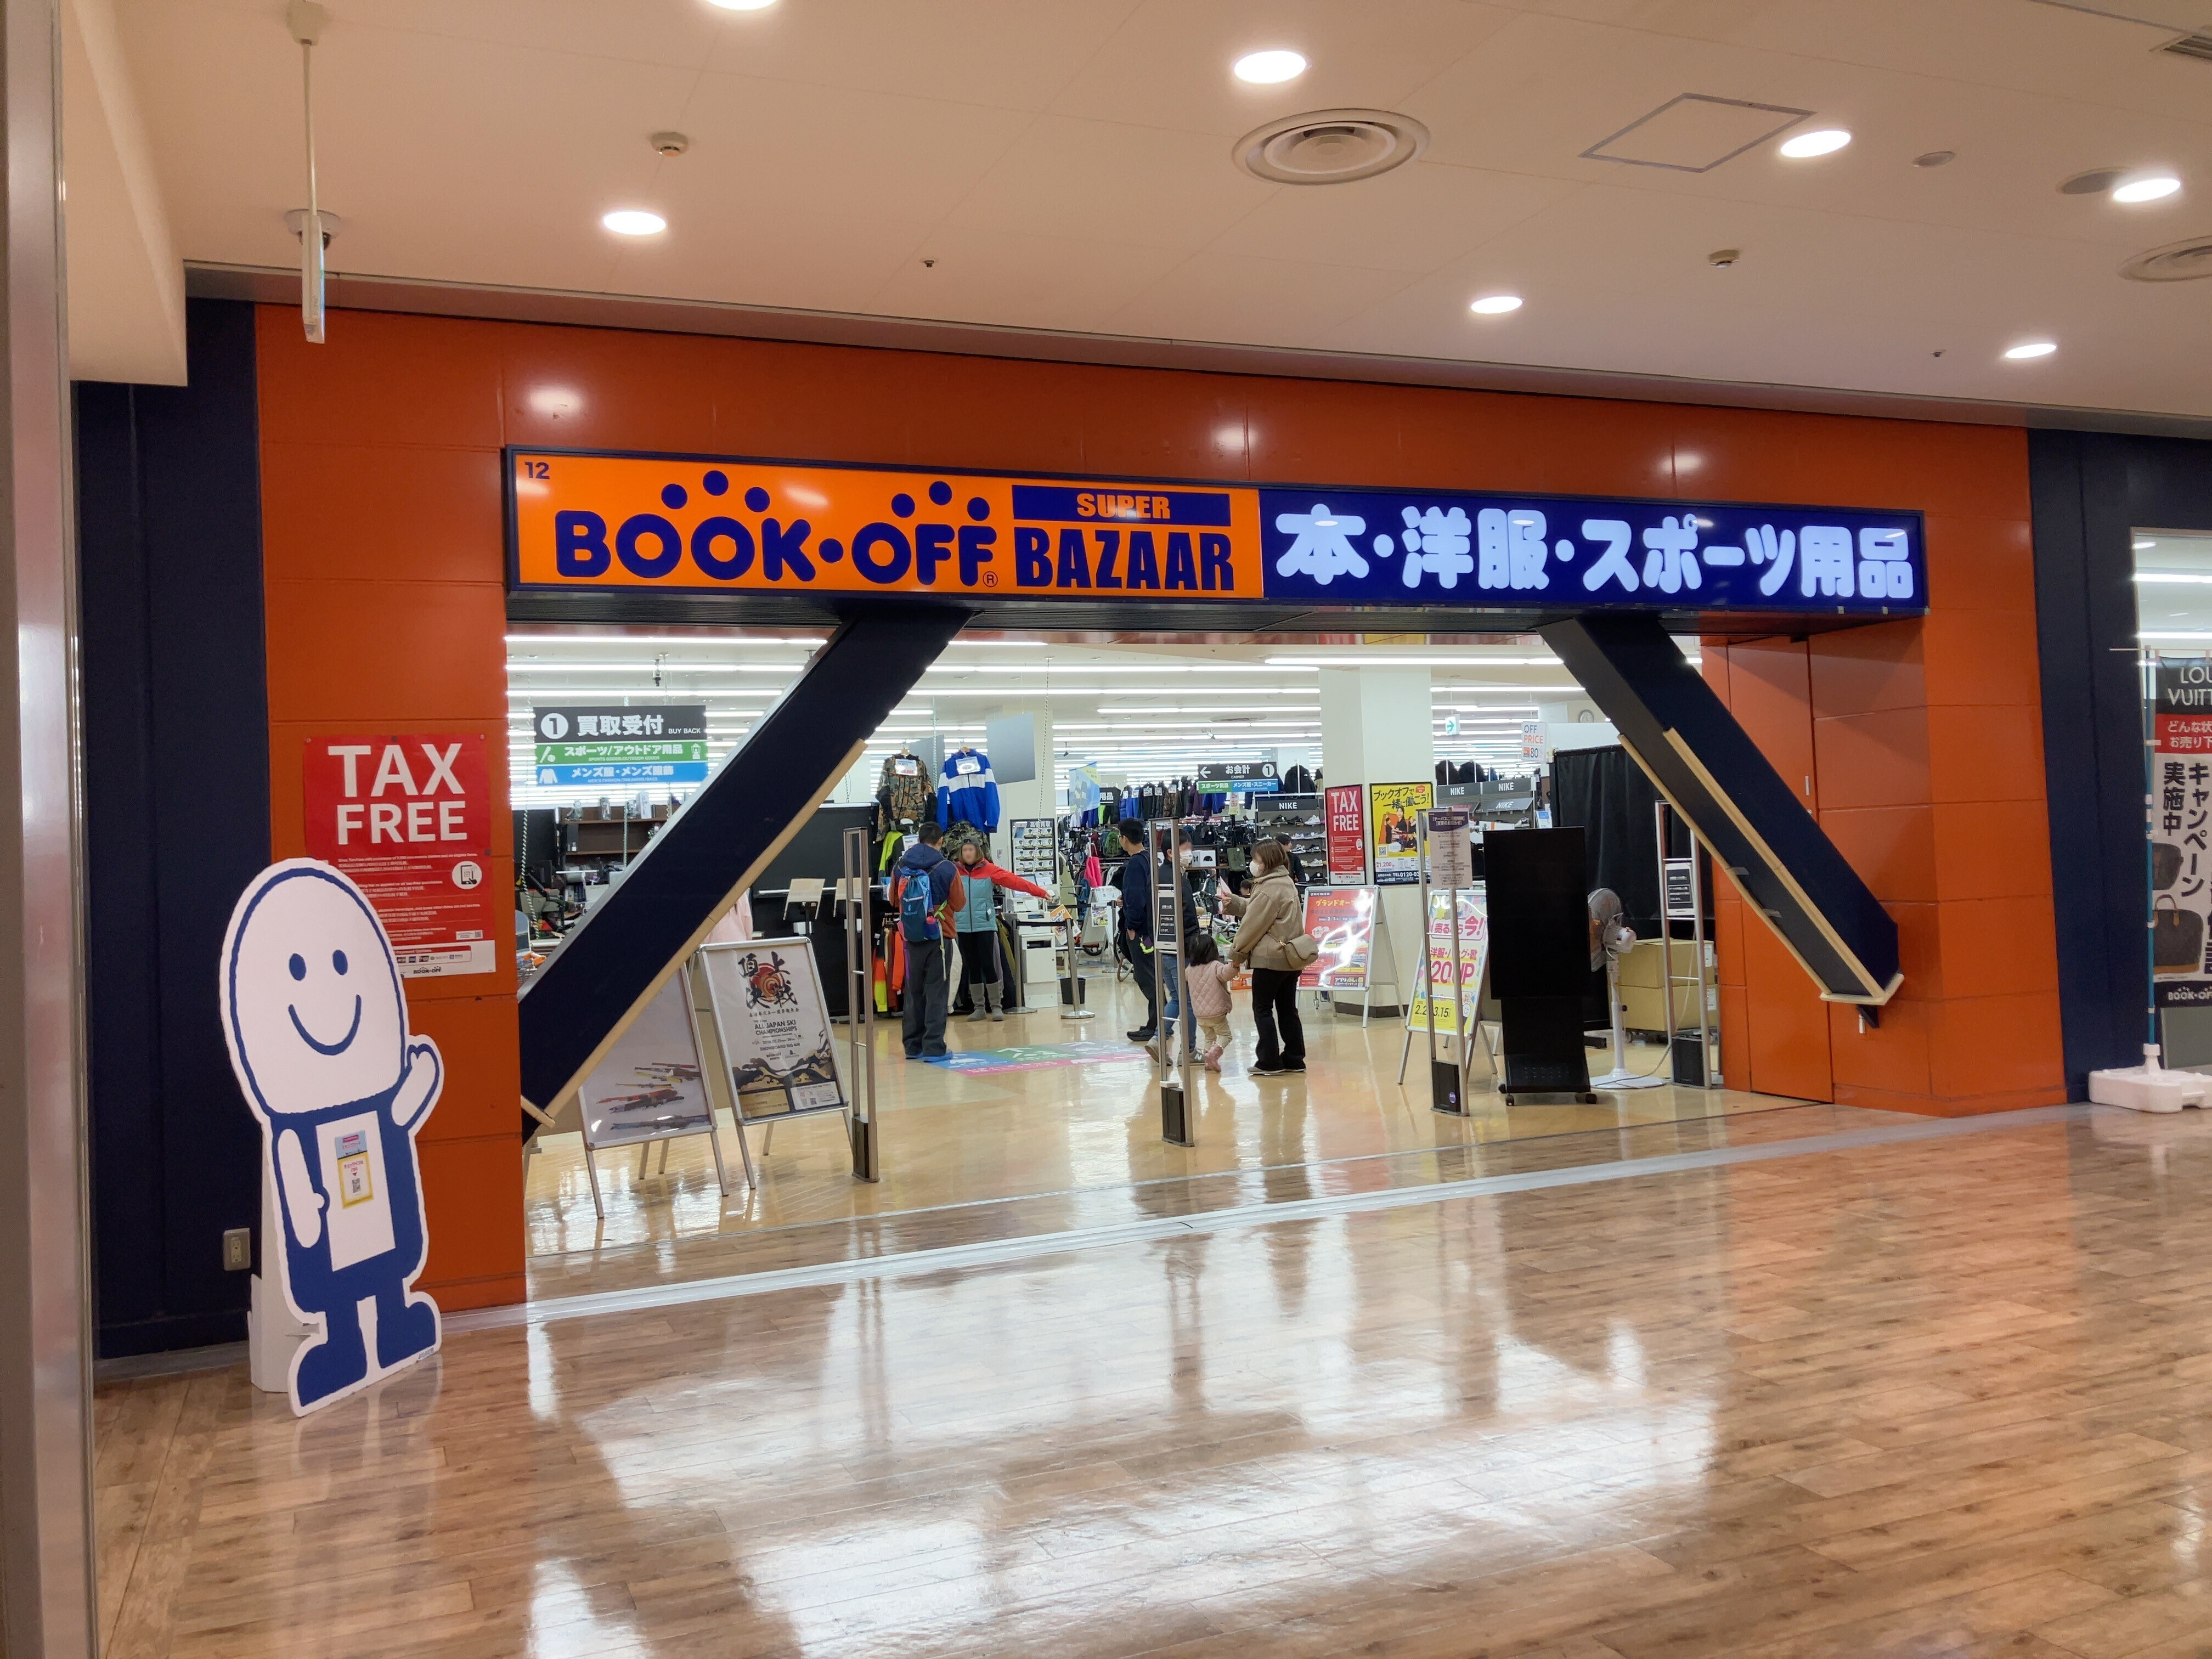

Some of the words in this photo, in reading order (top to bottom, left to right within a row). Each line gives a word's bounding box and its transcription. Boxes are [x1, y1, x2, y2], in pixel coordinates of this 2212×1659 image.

[524, 461, 550, 479] 12
[1077, 493, 1171, 520] SUPER
[1014, 526, 1234, 591] BAZAAR
[1276, 503, 1914, 600] 本・洋服・スポーツ用品
[577, 714, 664, 736] 買取受付
[1523, 724, 1537, 733] OFF
[1523, 735, 1543, 744] PRICE
[328, 743, 465, 798] TAX
[1225, 764, 1251, 775] お会計
[1373, 787, 1414, 801] ブックオフで
[1450, 787, 1465, 795] NIKE
[1498, 782, 1514, 792] NIKE
[1331, 790, 1358, 813] TAX
[2163, 761, 2186, 837] 実施中
[336, 800, 468, 845] FREE
[1333, 814, 1359, 832] FREE
[2181, 762, 2210, 898] キャンペーン
[755, 1026, 798, 1035] CHAMPIONSHIPS
